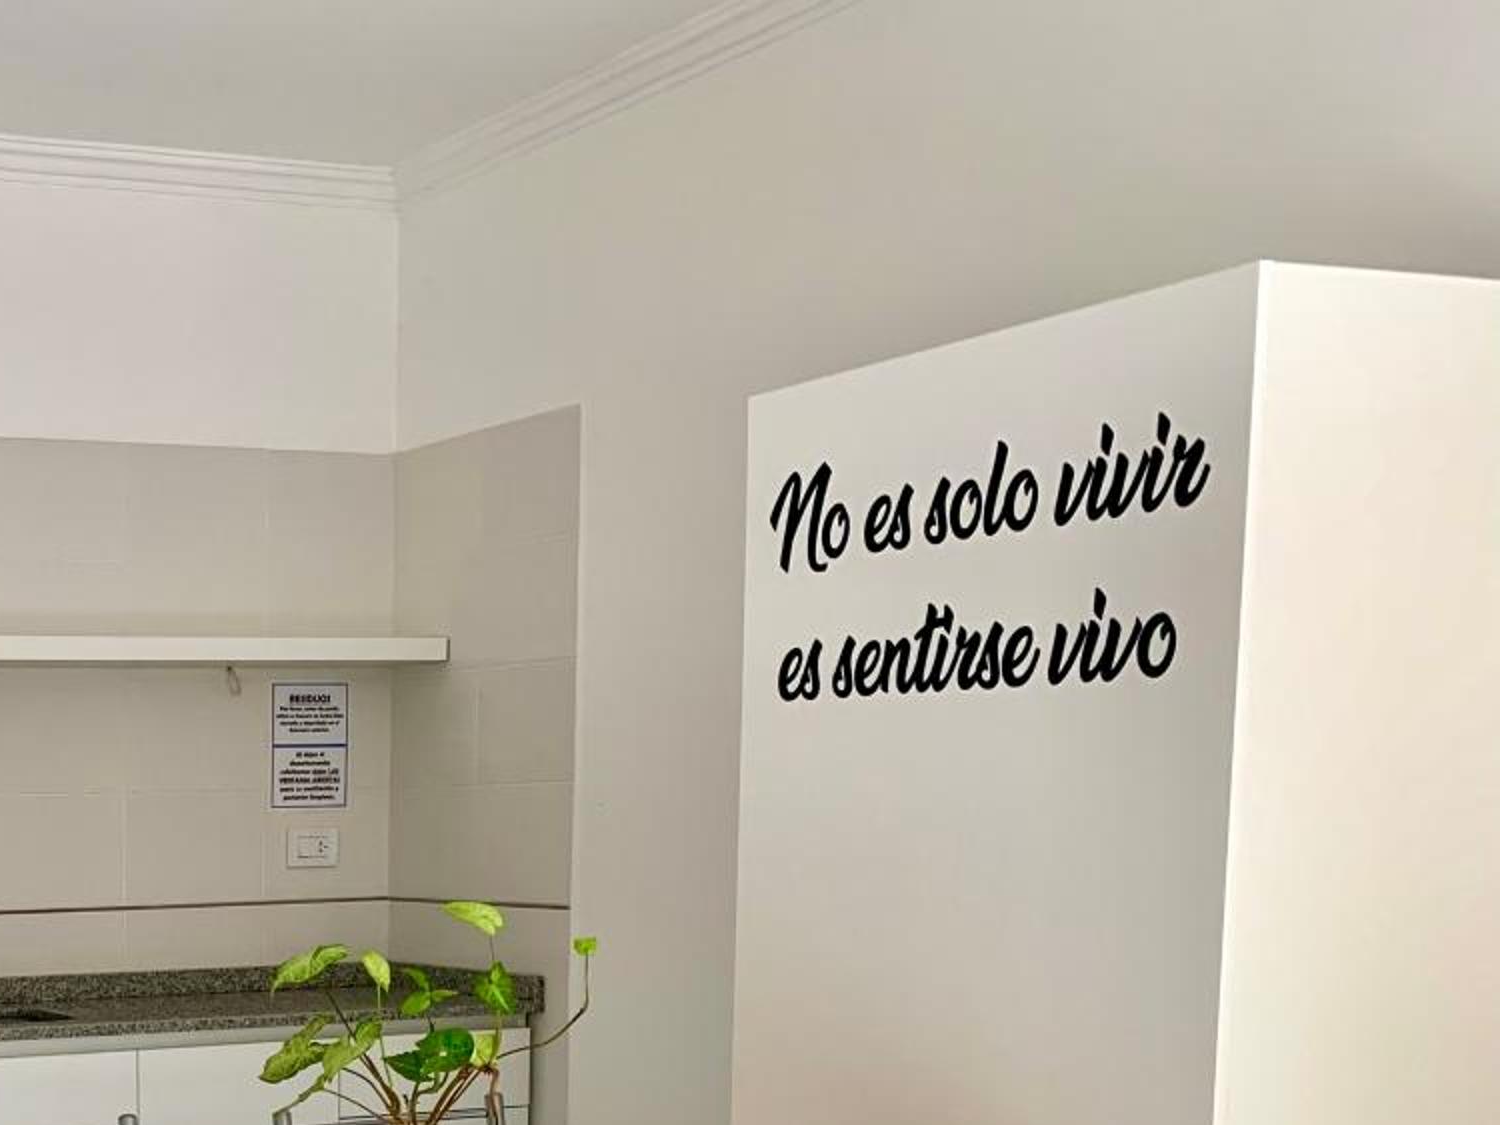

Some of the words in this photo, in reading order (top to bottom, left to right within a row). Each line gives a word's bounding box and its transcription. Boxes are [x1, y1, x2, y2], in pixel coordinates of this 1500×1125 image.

[770, 462, 850, 573] No
[863, 483, 915, 553] es
[924, 440, 1039, 545] solo
[1054, 411, 1211, 526] vivir
[778, 639, 823, 701] es
[832, 602, 1041, 699] sentirse
[1047, 587, 1177, 686] vivo
